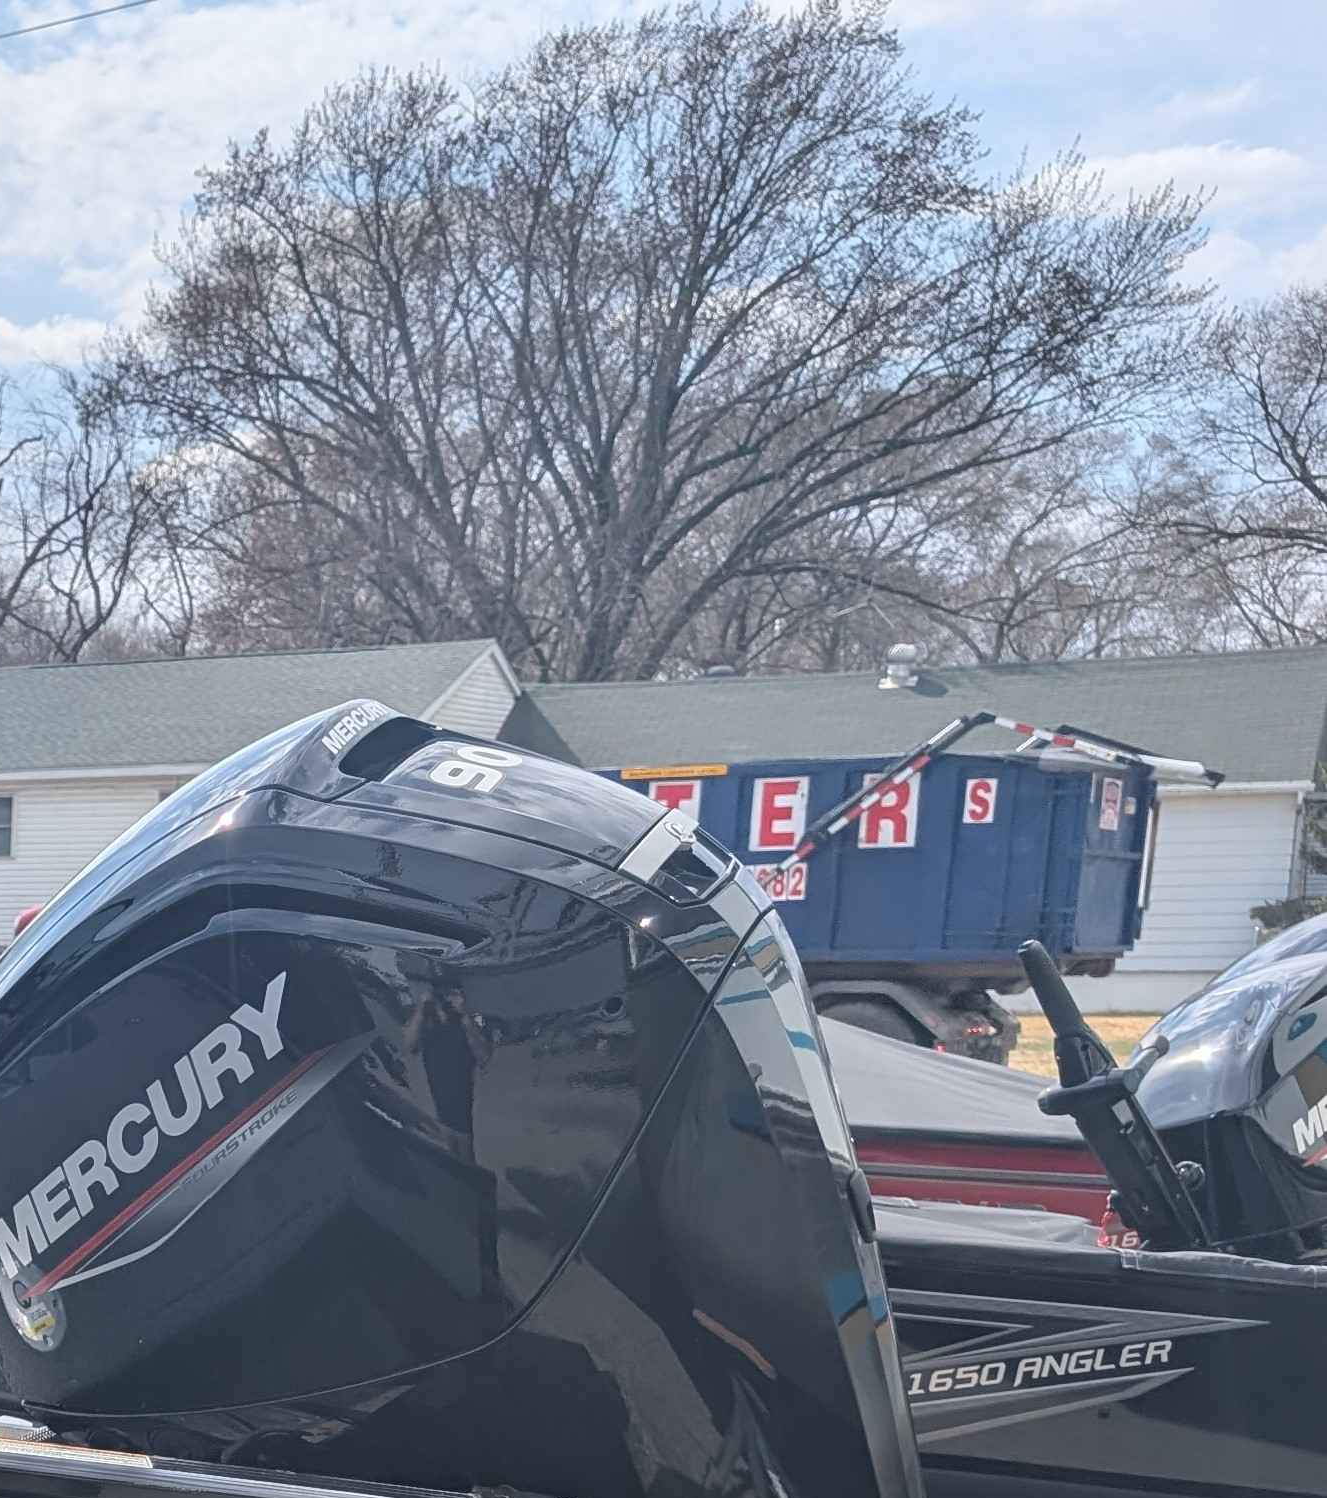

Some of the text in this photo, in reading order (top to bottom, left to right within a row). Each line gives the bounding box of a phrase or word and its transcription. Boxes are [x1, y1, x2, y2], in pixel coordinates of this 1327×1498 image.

[428, 746, 524, 793] 90
[181, 1087, 299, 1191] FOURSTROKE
[907, 1338, 1173, 1396] 1650 ANGLER
